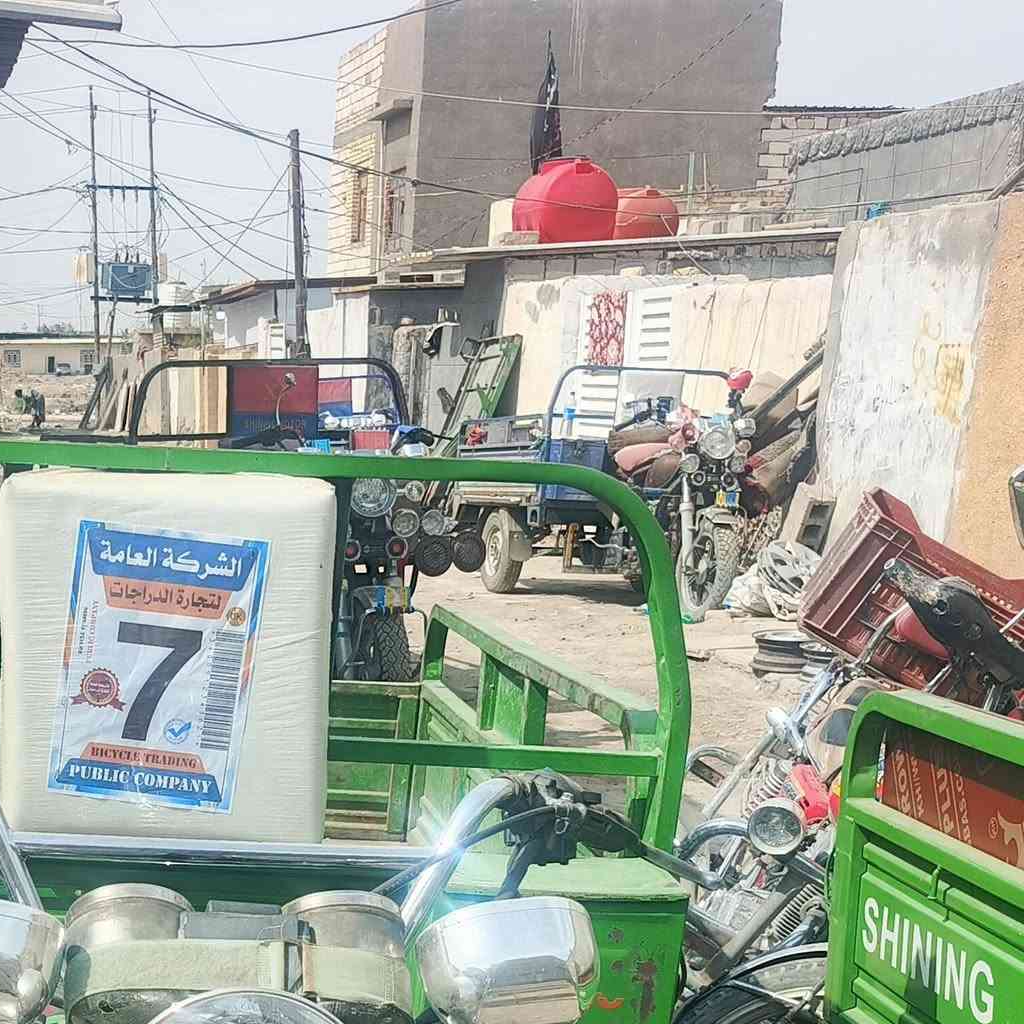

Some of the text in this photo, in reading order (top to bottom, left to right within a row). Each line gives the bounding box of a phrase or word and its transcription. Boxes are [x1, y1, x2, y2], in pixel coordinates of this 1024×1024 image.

[100, 539, 242, 580] الشركة العامة
[109, 581, 222, 612] لتجارة الدراجات
[117, 621, 203, 742] 7
[91, 747, 198, 769] BICYCLE TRADING
[69, 764, 212, 793] PUBLIC COMPANY
[861, 896, 994, 1024] SHINING
